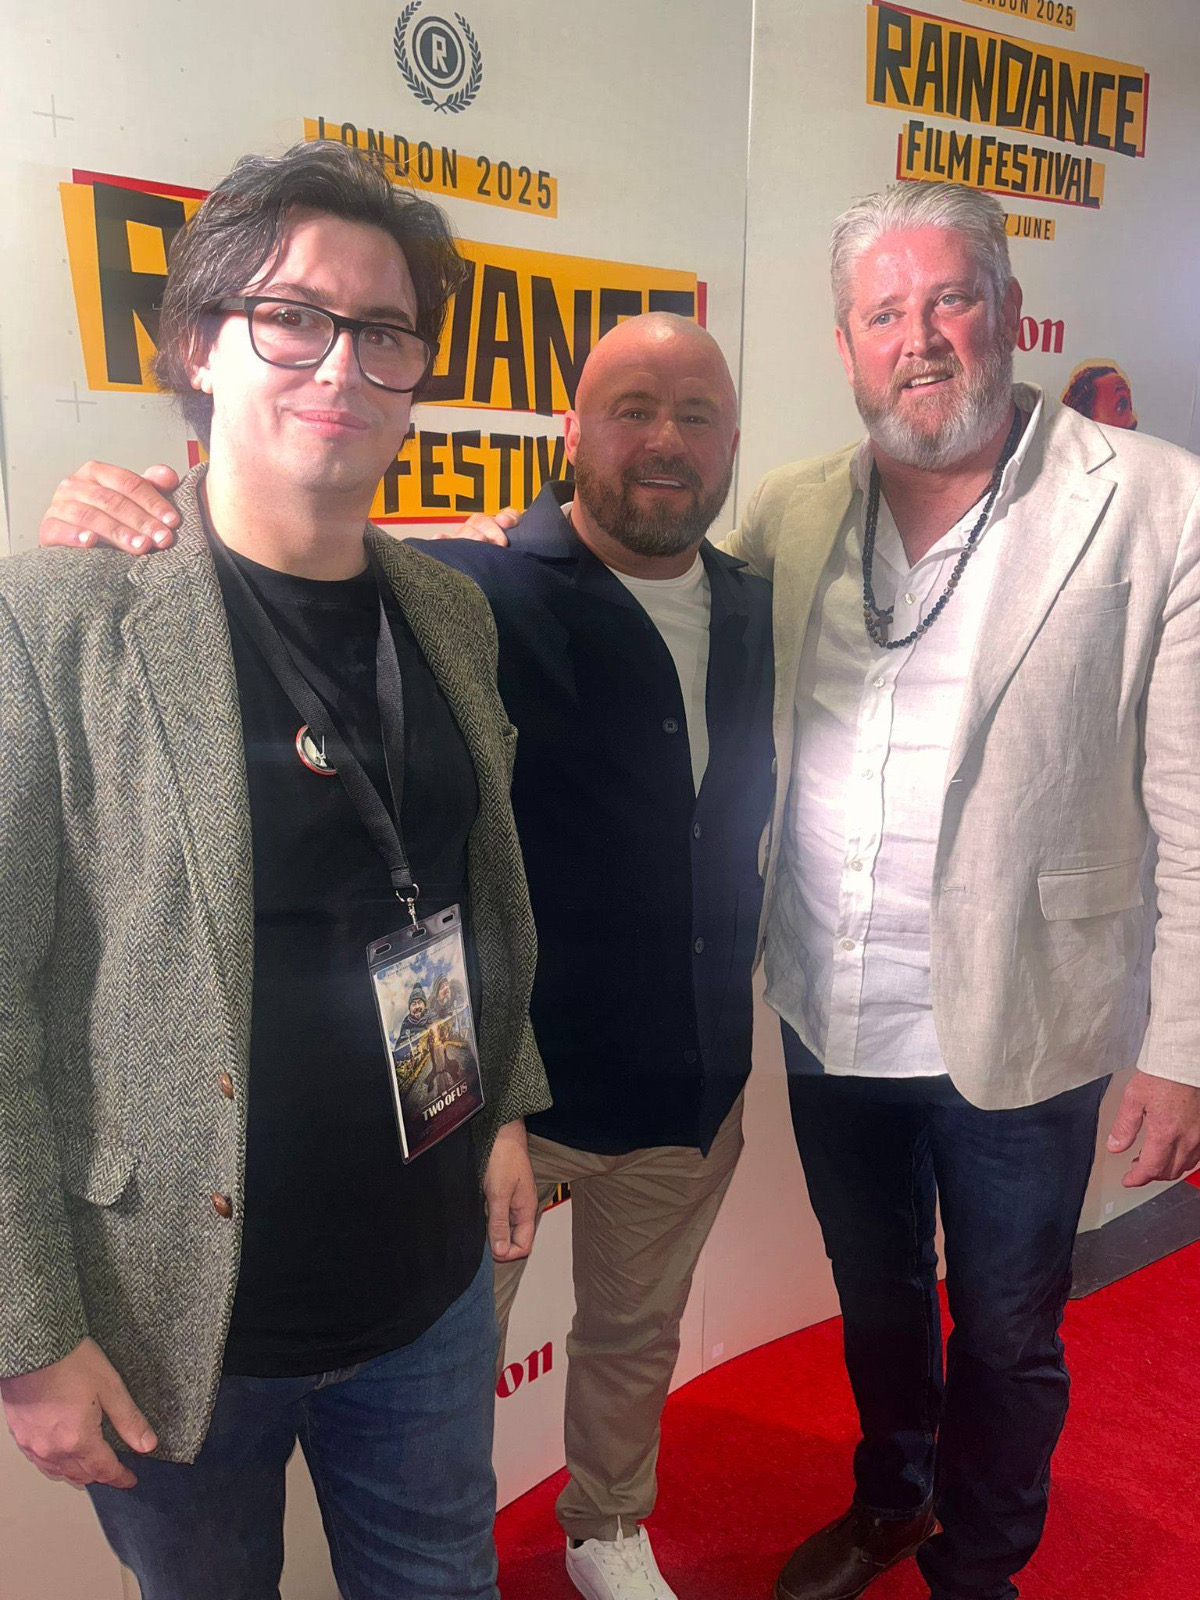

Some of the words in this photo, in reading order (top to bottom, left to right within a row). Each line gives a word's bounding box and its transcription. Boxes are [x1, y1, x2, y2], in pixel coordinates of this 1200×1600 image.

[1036, 0, 1074, 27] 2025
[431, 32, 449, 74] R
[873, 5, 1143, 158] RAINDANCE
[476, 155, 551, 210] 2025
[906, 119, 973, 182] FILM
[977, 135, 1101, 205] FESTIVAL
[1014, 215, 1052, 241] JUNE
[421, 1099, 445, 1122] TWO
[444, 1089, 457, 1106] OF
[456, 1081, 468, 1098] US
